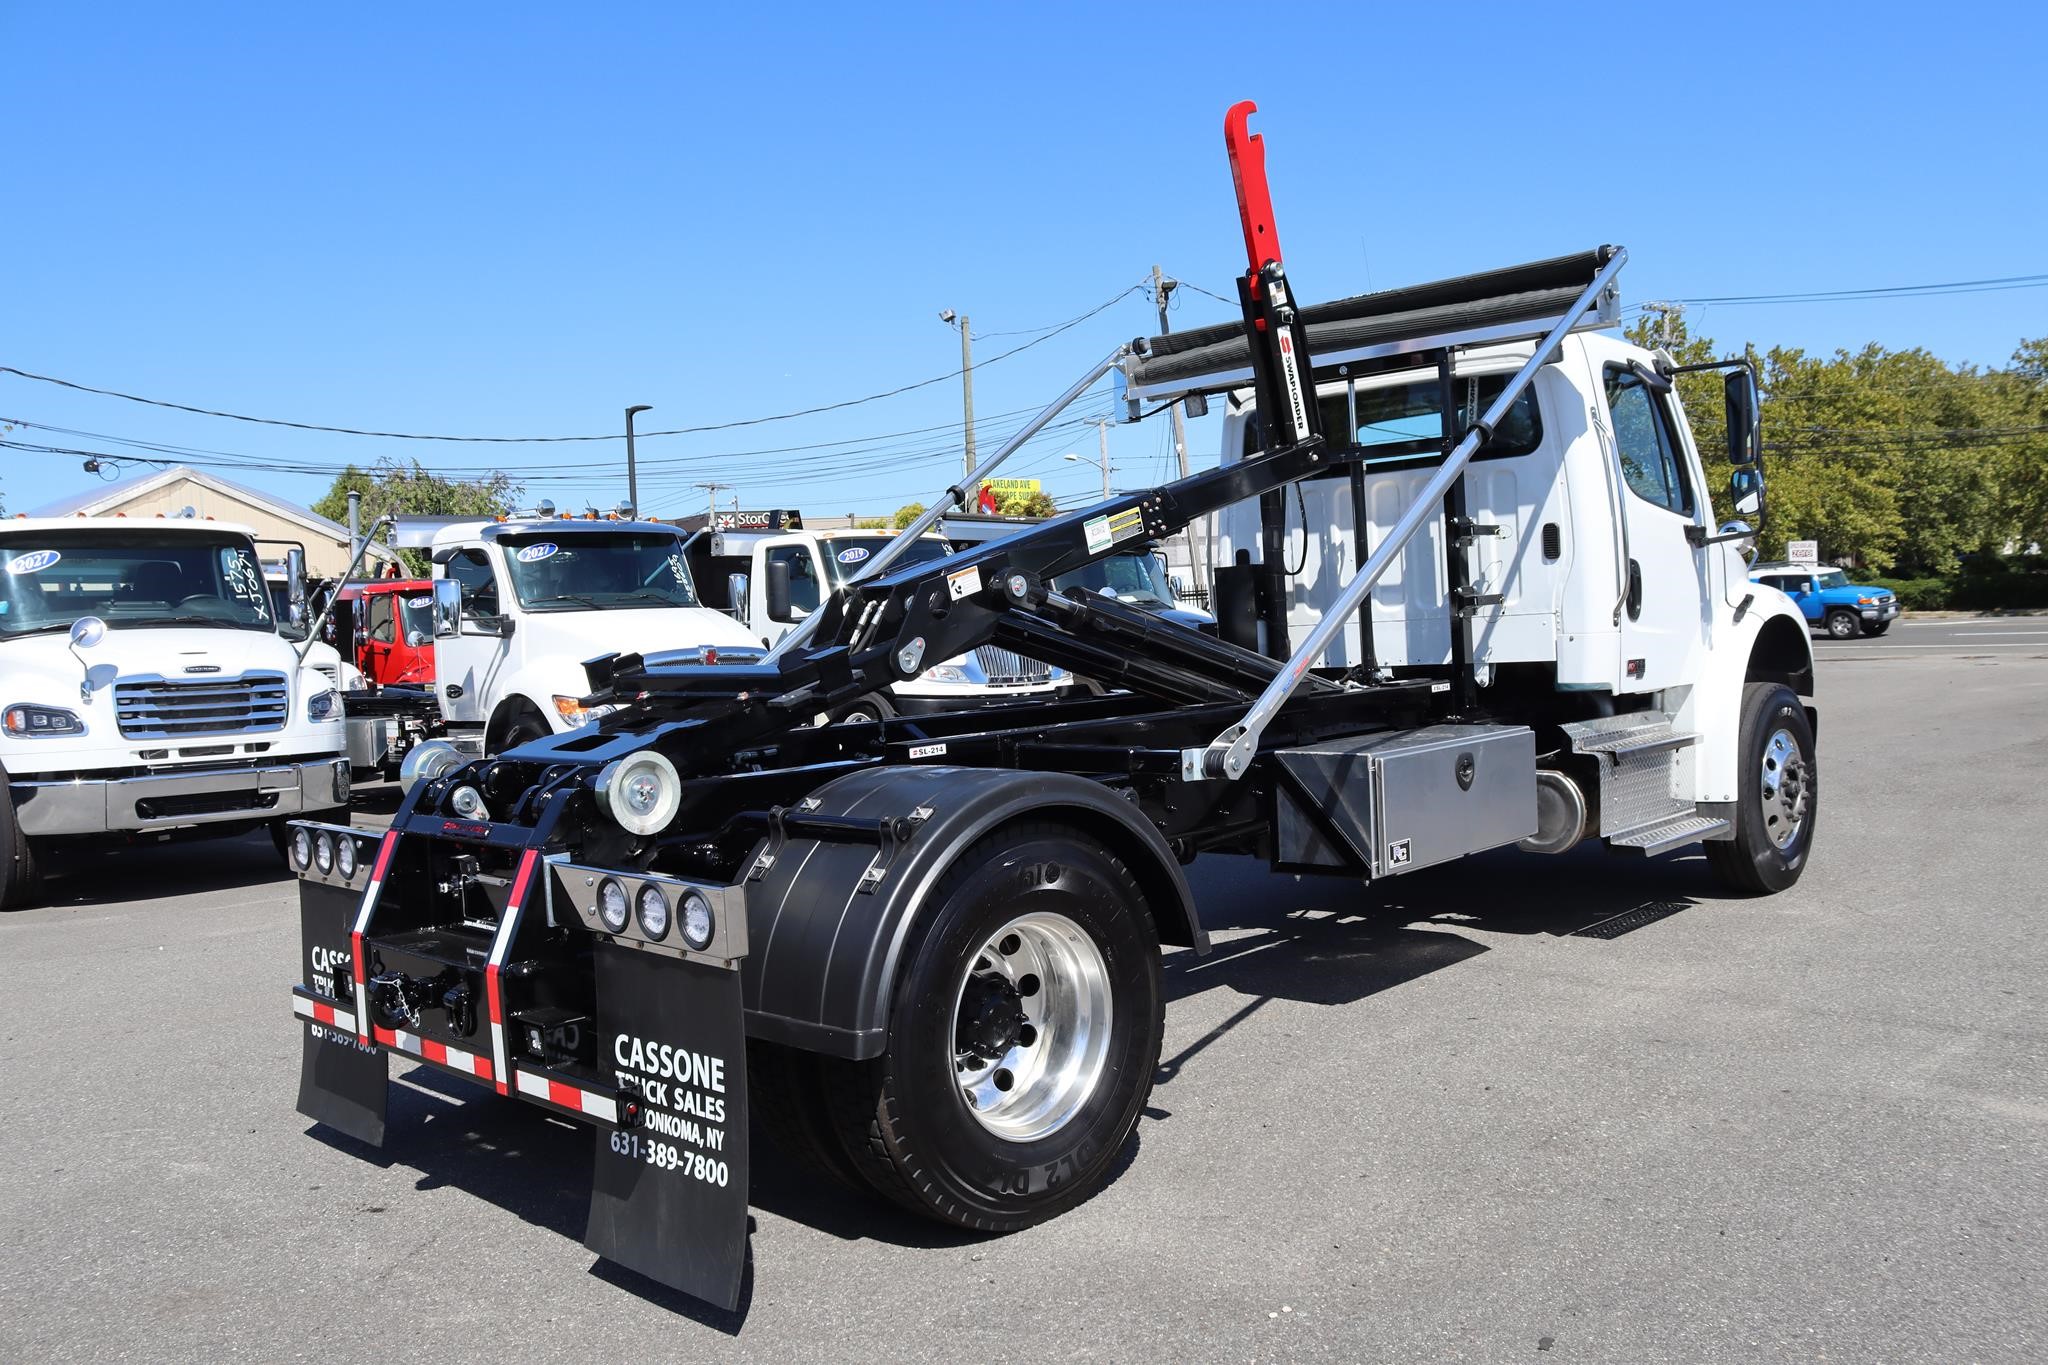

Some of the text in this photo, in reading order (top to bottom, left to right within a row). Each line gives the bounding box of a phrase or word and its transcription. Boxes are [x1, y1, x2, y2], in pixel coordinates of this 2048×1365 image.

[1285, 356, 1304, 430] SWAPLOADER
[1020, 480, 1031, 489] AVE
[16, 551, 50, 572] 2027
[524, 544, 550, 561] 2027
[844, 549, 864, 561] 2019
[227, 555, 249, 599] 1575
[312, 946, 351, 975] CASS
[614, 1033, 726, 1094] CASSONE
[674, 1087, 726, 1123] SALES
[644, 1108, 725, 1151] ONKOMA, NY
[610, 1130, 729, 1188] 631-389-7800
